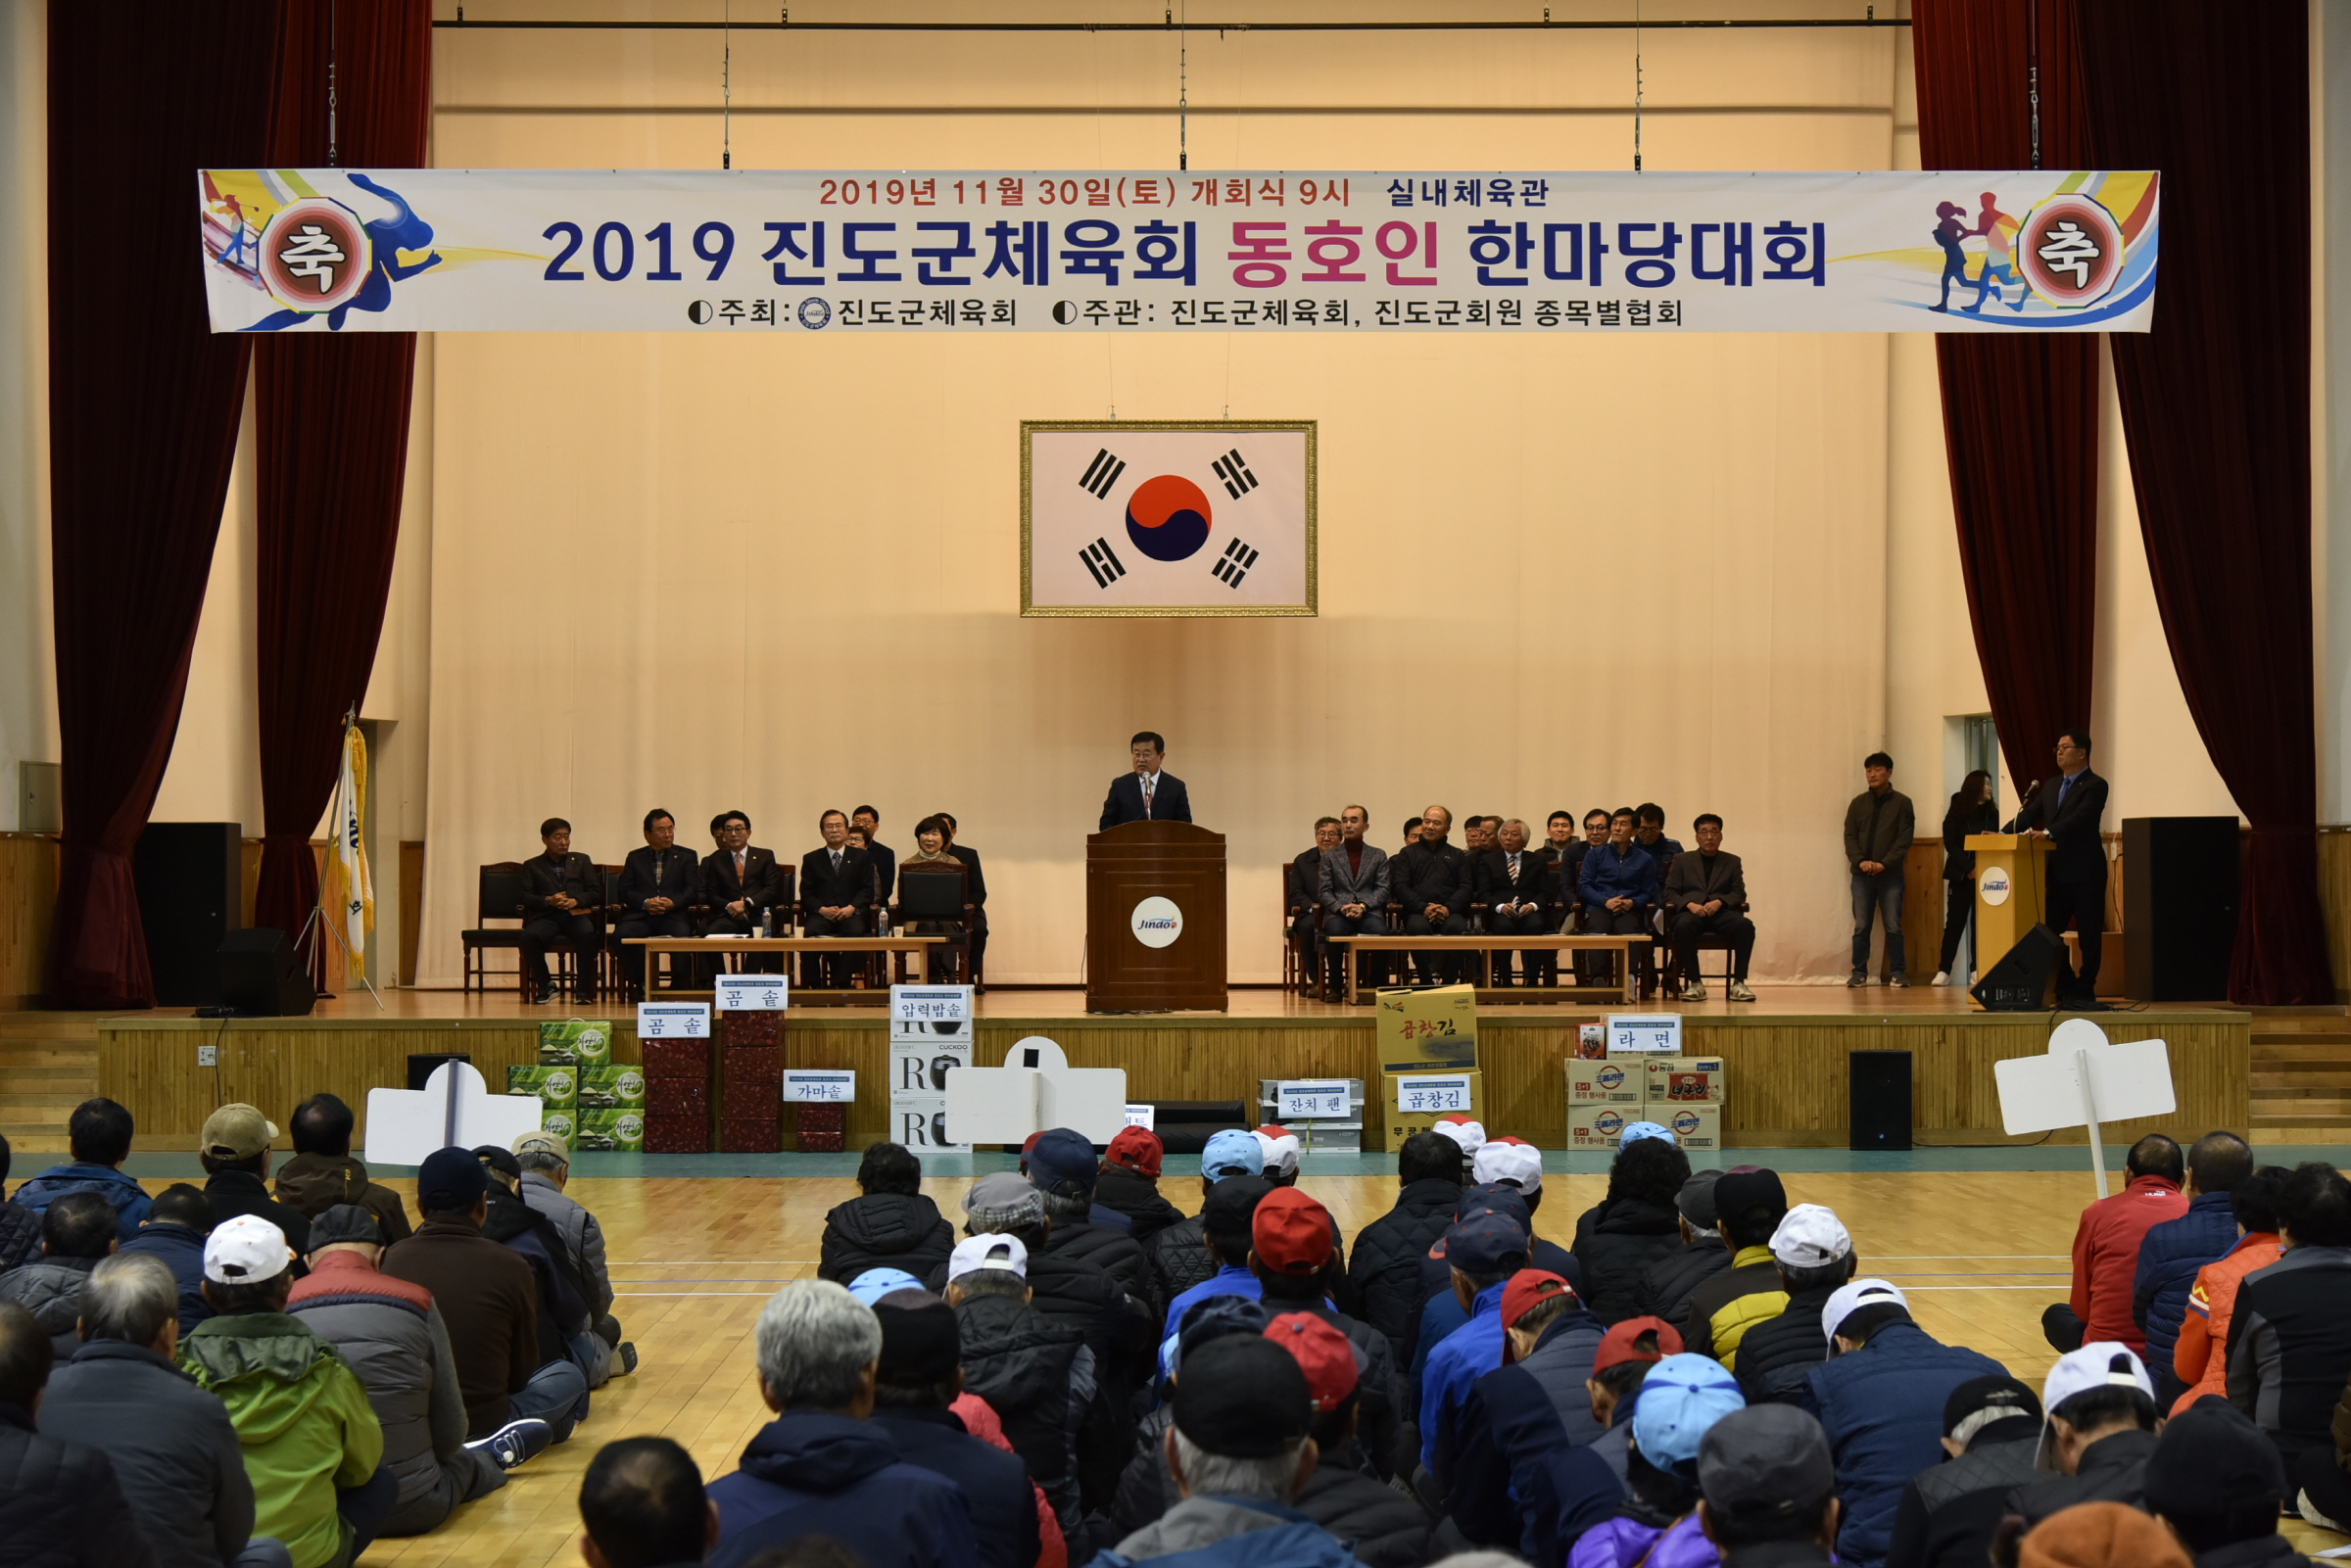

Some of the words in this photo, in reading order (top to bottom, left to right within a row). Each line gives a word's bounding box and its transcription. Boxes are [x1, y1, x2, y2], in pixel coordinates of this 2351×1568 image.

[821, 178, 936, 206] 2019년
[954, 177, 1023, 206] 11월
[1038, 177, 1175, 208] 30일(토)
[1191, 178, 1283, 207] 개회식
[1300, 178, 1348, 207] 9시
[1387, 179, 1549, 208] 실내체육관
[278, 223, 346, 293] 축
[542, 221, 735, 281] 2019
[761, 219, 1196, 286] 진도군체육회
[1228, 219, 1437, 288] 동호인
[1467, 219, 1825, 288] 한마당대회
[2039, 221, 2101, 290] 축
[839, 299, 1015, 326] 진도군체육회
[1172, 299, 1360, 327] 진도군체육회,
[1374, 300, 1521, 326] 진도군회원
[1534, 300, 1681, 326] 종목별협회
[1982, 882, 2004, 891] Jindo
[1137, 920, 1171, 929] Jindo
[726, 990, 744, 1007] 곰
[761, 989, 780, 1007] 솥
[901, 1003, 961, 1019] 압력밥솥
[648, 1019, 665, 1035] 곰
[684, 1018, 701, 1035] 솥
[1399, 1019, 1457, 1040] 곱창김
[797, 1084, 841, 1099] 가마솥
[1671, 1083, 1706, 1096] 너구리
[1289, 1098, 1317, 1113] 잔치
[1326, 1097, 1340, 1112] 팬
[1408, 1090, 1460, 1109] 곱창김
